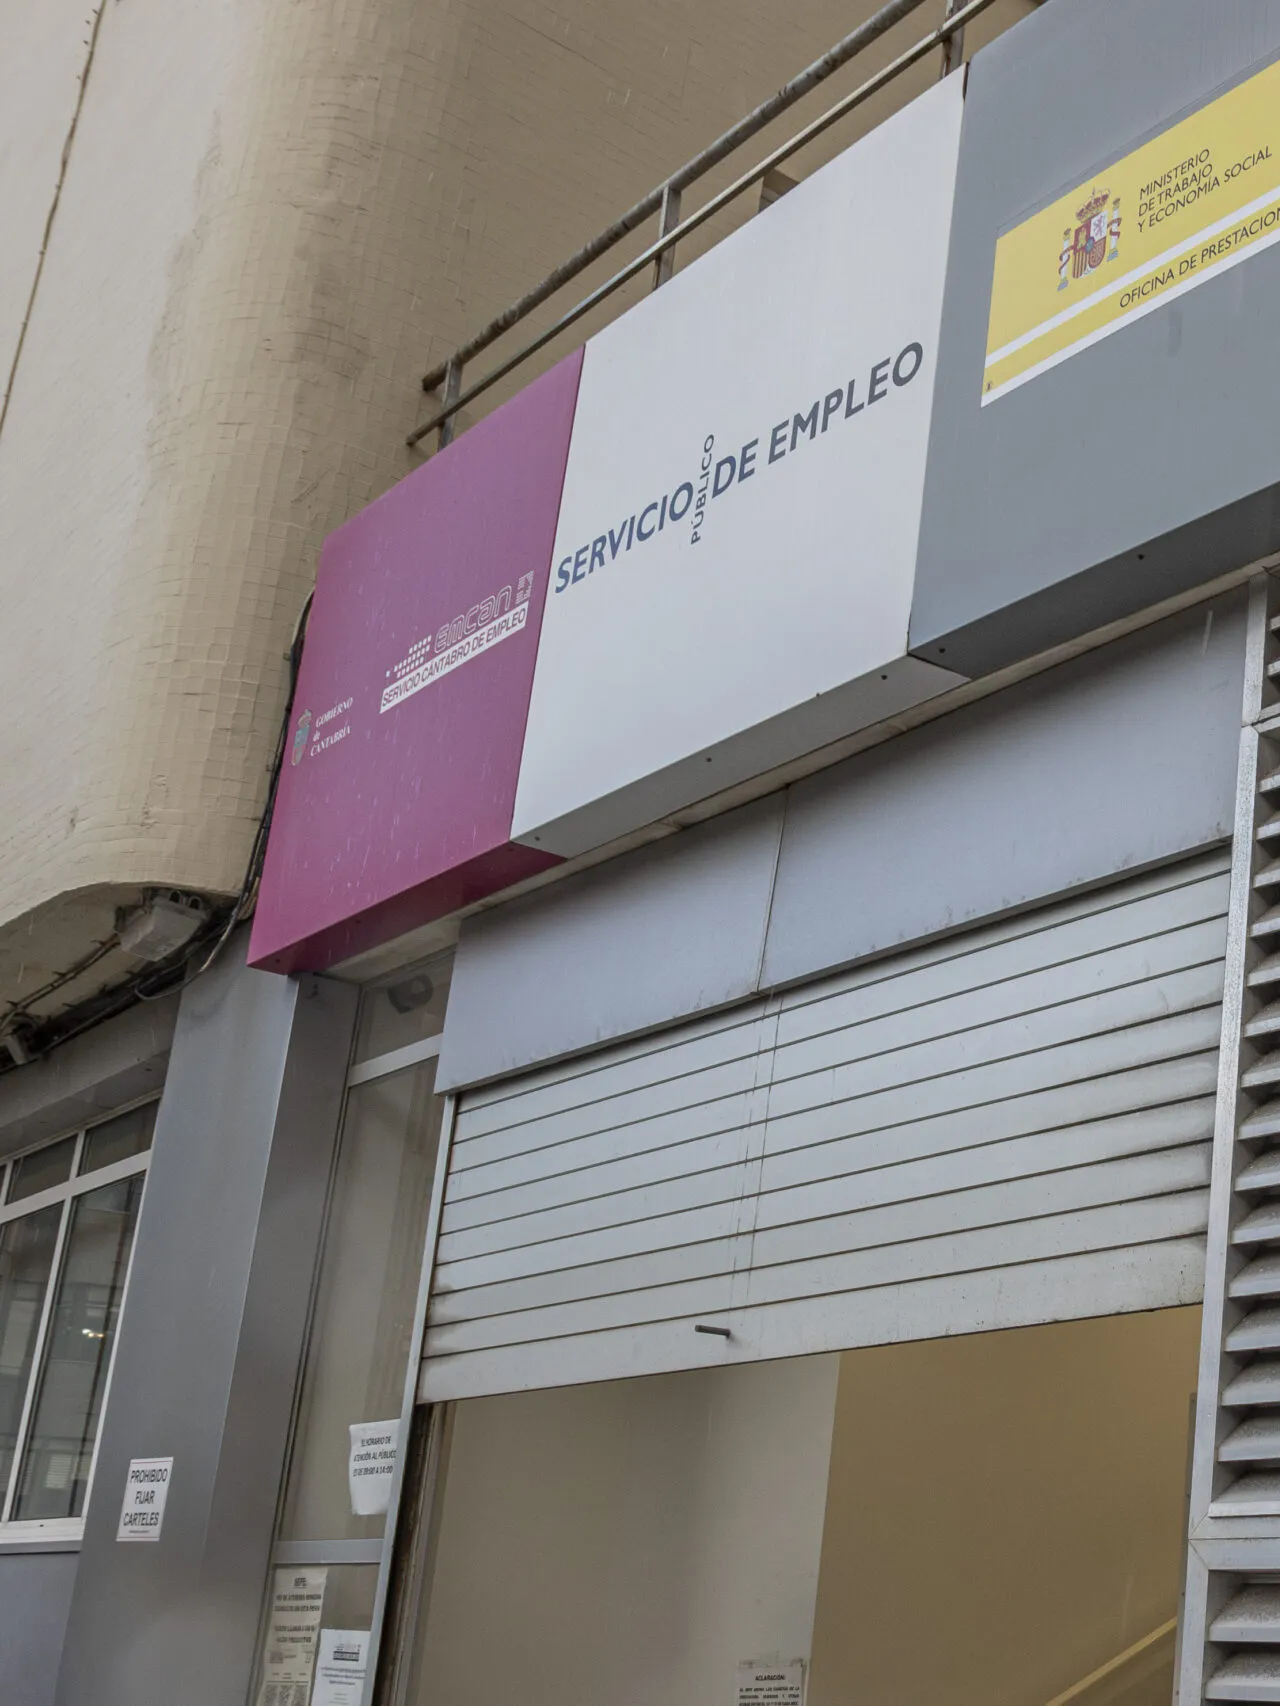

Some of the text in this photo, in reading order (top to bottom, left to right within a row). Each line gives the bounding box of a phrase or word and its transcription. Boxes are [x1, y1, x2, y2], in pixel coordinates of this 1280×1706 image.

[1138, 145, 1273, 233] Y ECONOMÍA SOCIAL
[1139, 163, 1213, 217] DE TRABAJO
[1140, 149, 1210, 200] MINISTERIO
[1119, 268, 1175, 308] OFICINA
[1179, 254, 1197, 276] DE
[555, 342, 923, 594] SERVICIO DE EMPLEO
[691, 434, 714, 545] PÚBLICO
[435, 585, 512, 653] emcan
[382, 672, 420, 707] SERVICIO
[472, 632, 485, 651] DE
[486, 607, 526, 643] EMPLEO
[315, 697, 353, 728] GOBIERNO
[131, 1468, 168, 1483] PROHIBIDO
[123, 1512, 160, 1526] CARTELES
